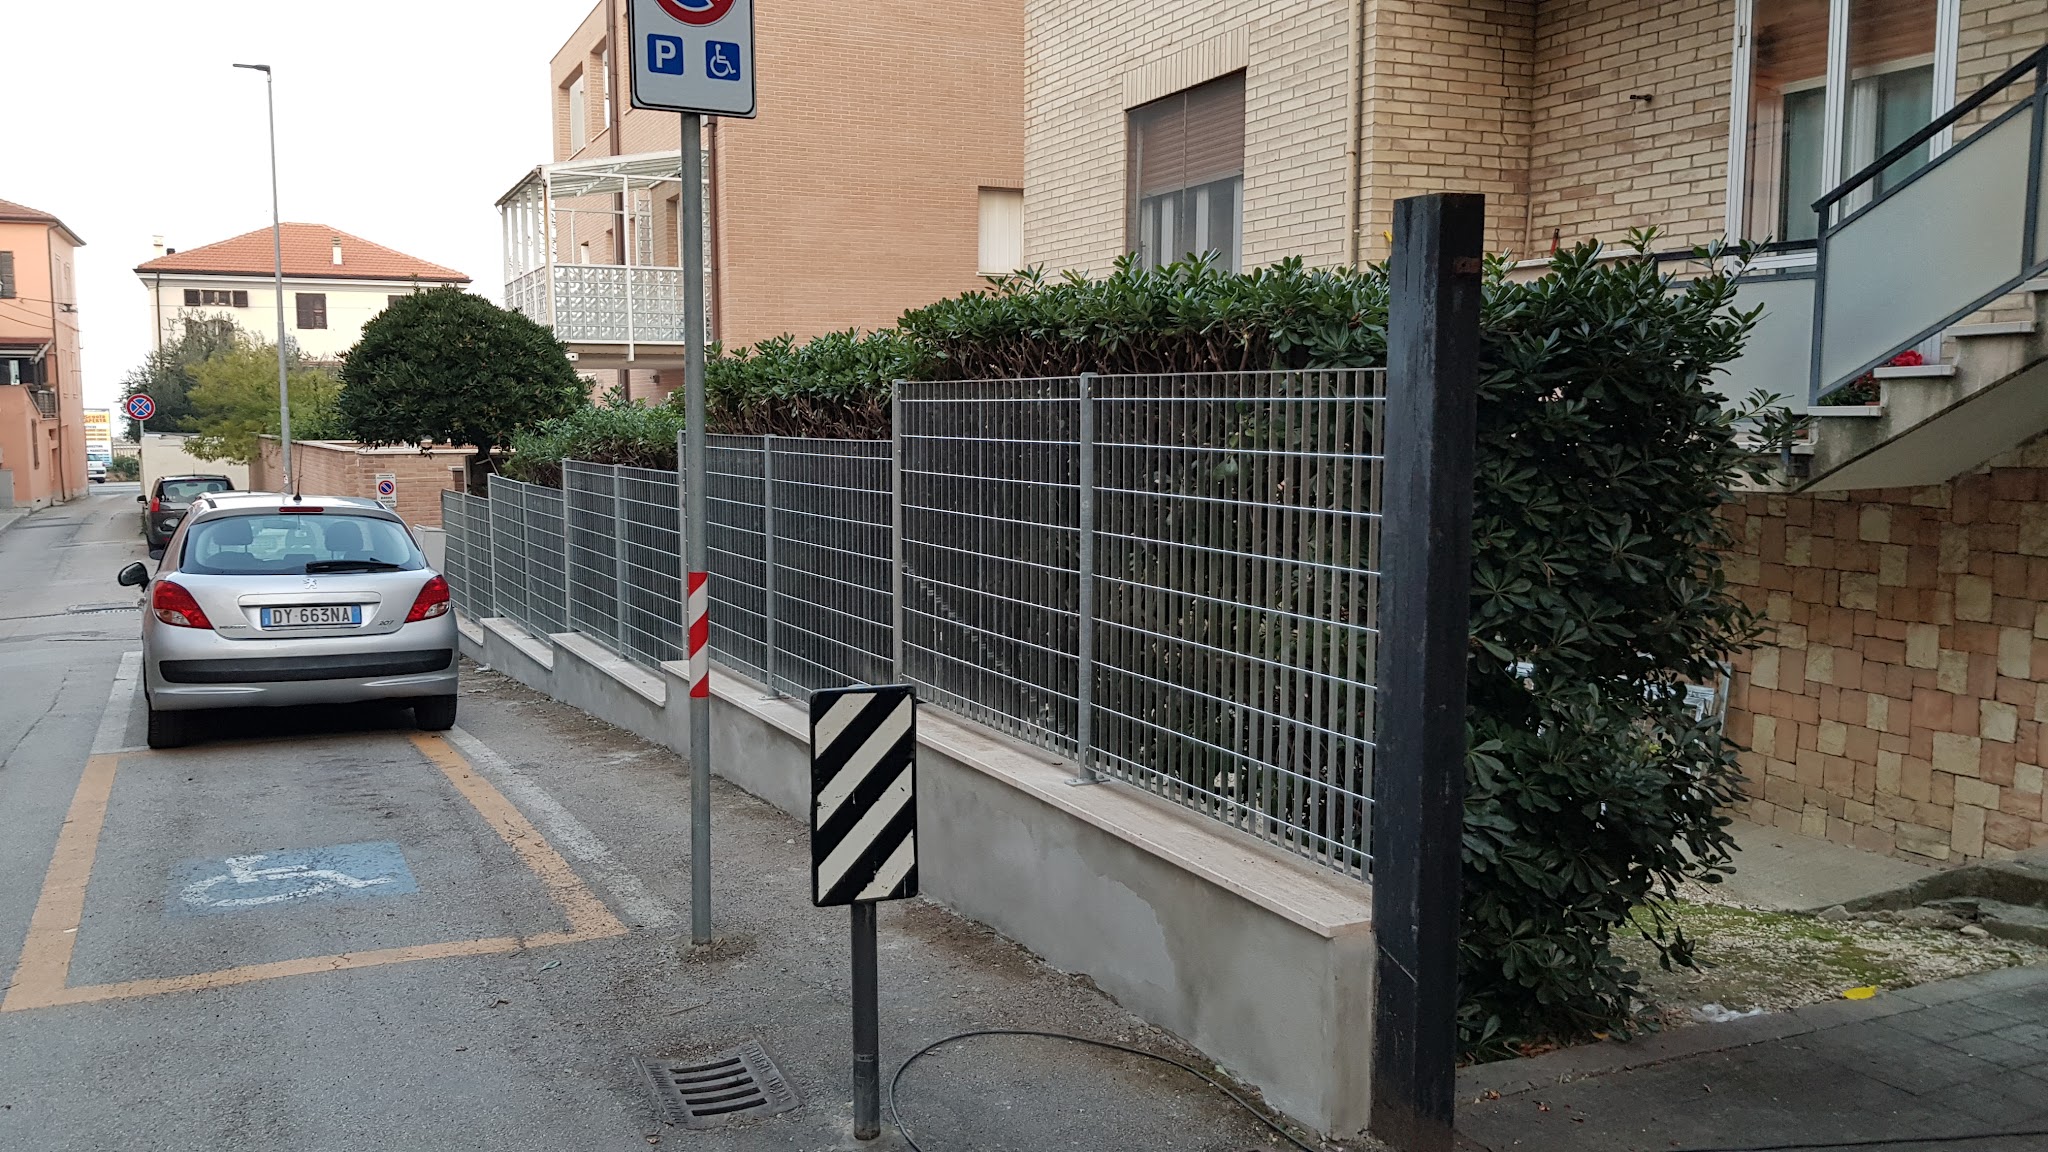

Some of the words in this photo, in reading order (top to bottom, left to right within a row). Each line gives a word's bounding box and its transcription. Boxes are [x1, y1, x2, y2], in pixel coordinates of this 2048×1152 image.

[655, 39, 677, 69] P
[273, 609, 292, 624] DY
[300, 608, 351, 623] 663NA
